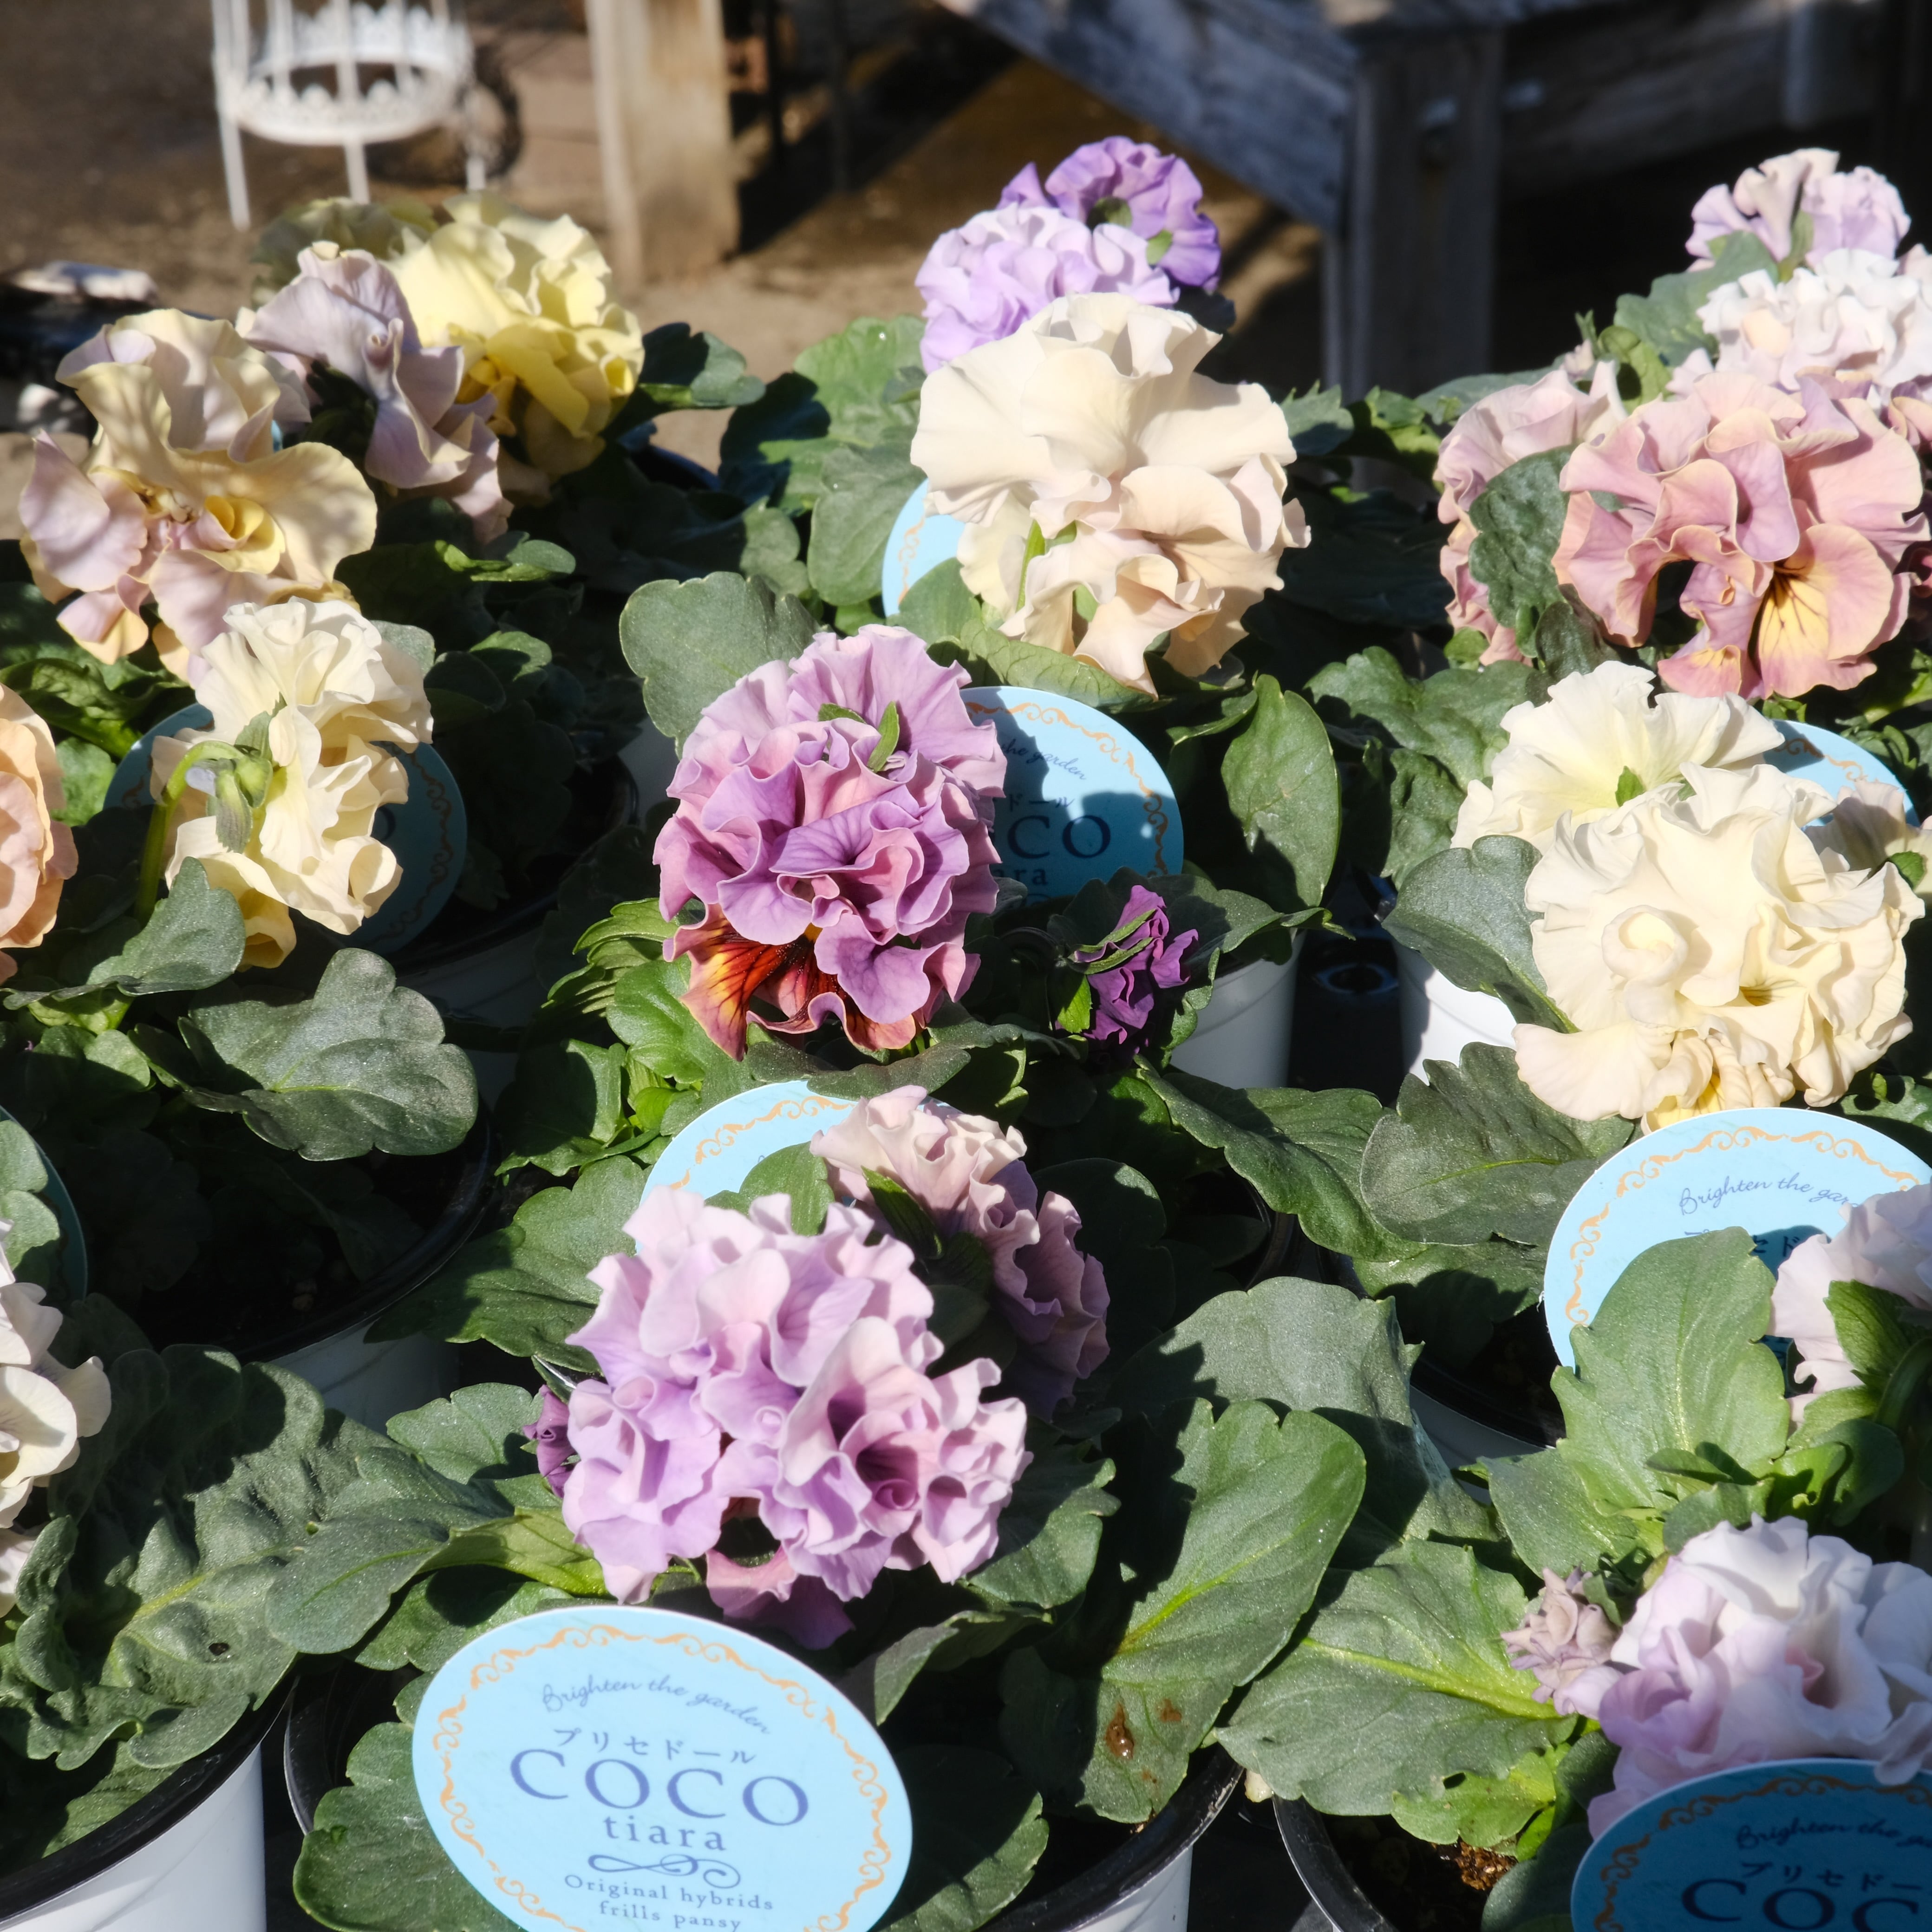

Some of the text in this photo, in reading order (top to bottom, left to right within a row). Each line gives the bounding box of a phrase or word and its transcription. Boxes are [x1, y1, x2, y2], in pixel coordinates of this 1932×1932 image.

[1027, 750, 1087, 781] garden
[1679, 1175, 1773, 1216] Brighten
[1777, 1172, 1815, 1193] the
[542, 1674, 770, 1735] Brighten the garden
[554, 1727, 756, 1764] プリセドール
[510, 1749, 809, 1826] COCO
[603, 1815, 727, 1851] tiara
[1736, 1817, 1902, 1850] Brighten the
[564, 1874, 773, 1910] Original hybrids
[599, 1900, 741, 1932] frills pansy
